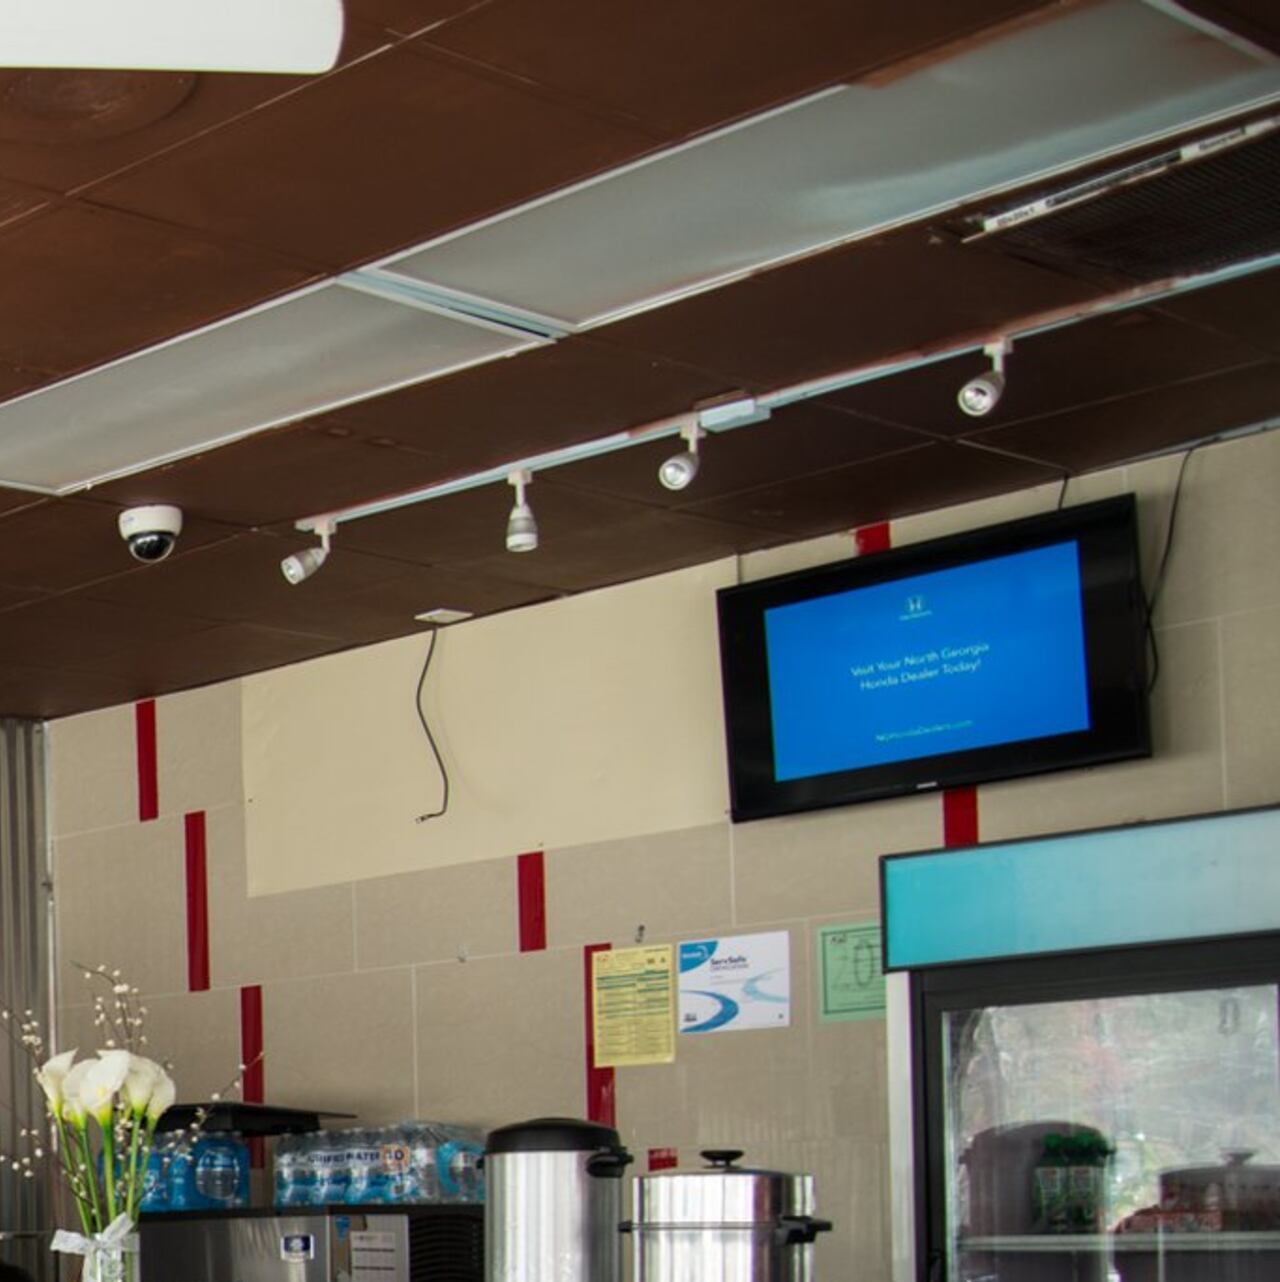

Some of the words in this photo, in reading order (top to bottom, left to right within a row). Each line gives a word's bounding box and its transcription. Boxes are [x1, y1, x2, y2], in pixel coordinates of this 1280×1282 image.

[904, 650, 939, 667] North
[941, 643, 989, 658] Georgia
[860, 676, 898, 691] Honda
[900, 668, 939, 683] Dealer
